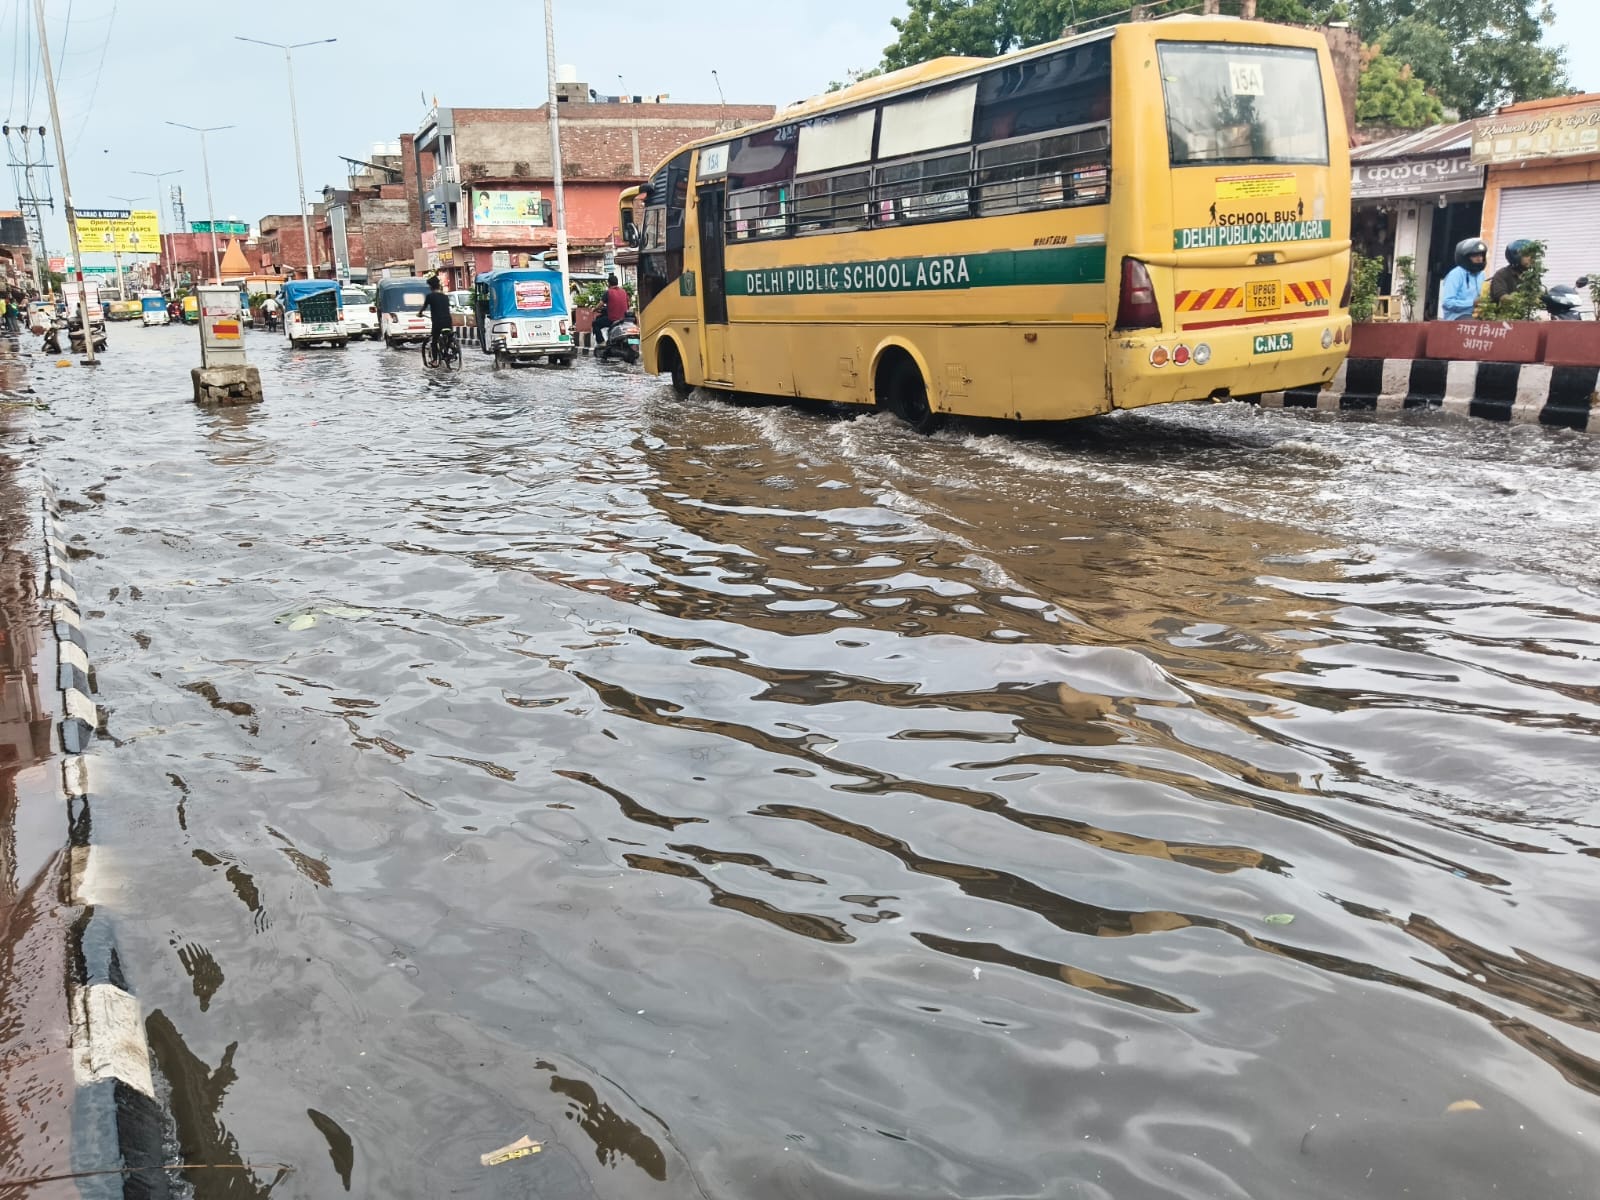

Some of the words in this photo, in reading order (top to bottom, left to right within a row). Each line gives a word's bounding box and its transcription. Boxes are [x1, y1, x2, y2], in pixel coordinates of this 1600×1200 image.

[1233, 68, 1260, 91] 15A
[707, 153, 719, 171] 15A
[1219, 212, 1271, 226] SCHOOL
[1274, 210, 1297, 223] BUS
[1183, 226, 1216, 249] DELHI
[1219, 224, 1257, 245] PUBLIC
[1259, 221, 1298, 243] SCHOOL
[1299, 220, 1324, 238] AGRA
[747, 271, 783, 293] DELHI
[787, 268, 839, 292] PUBLIC
[843, 264, 911, 289] SCHOOL
[916, 257, 970, 286] AGRA
[1456, 323, 1478, 336] नगर
[1255, 334, 1292, 352] C.N.G.
[1463, 338, 1493, 352] आगरा
